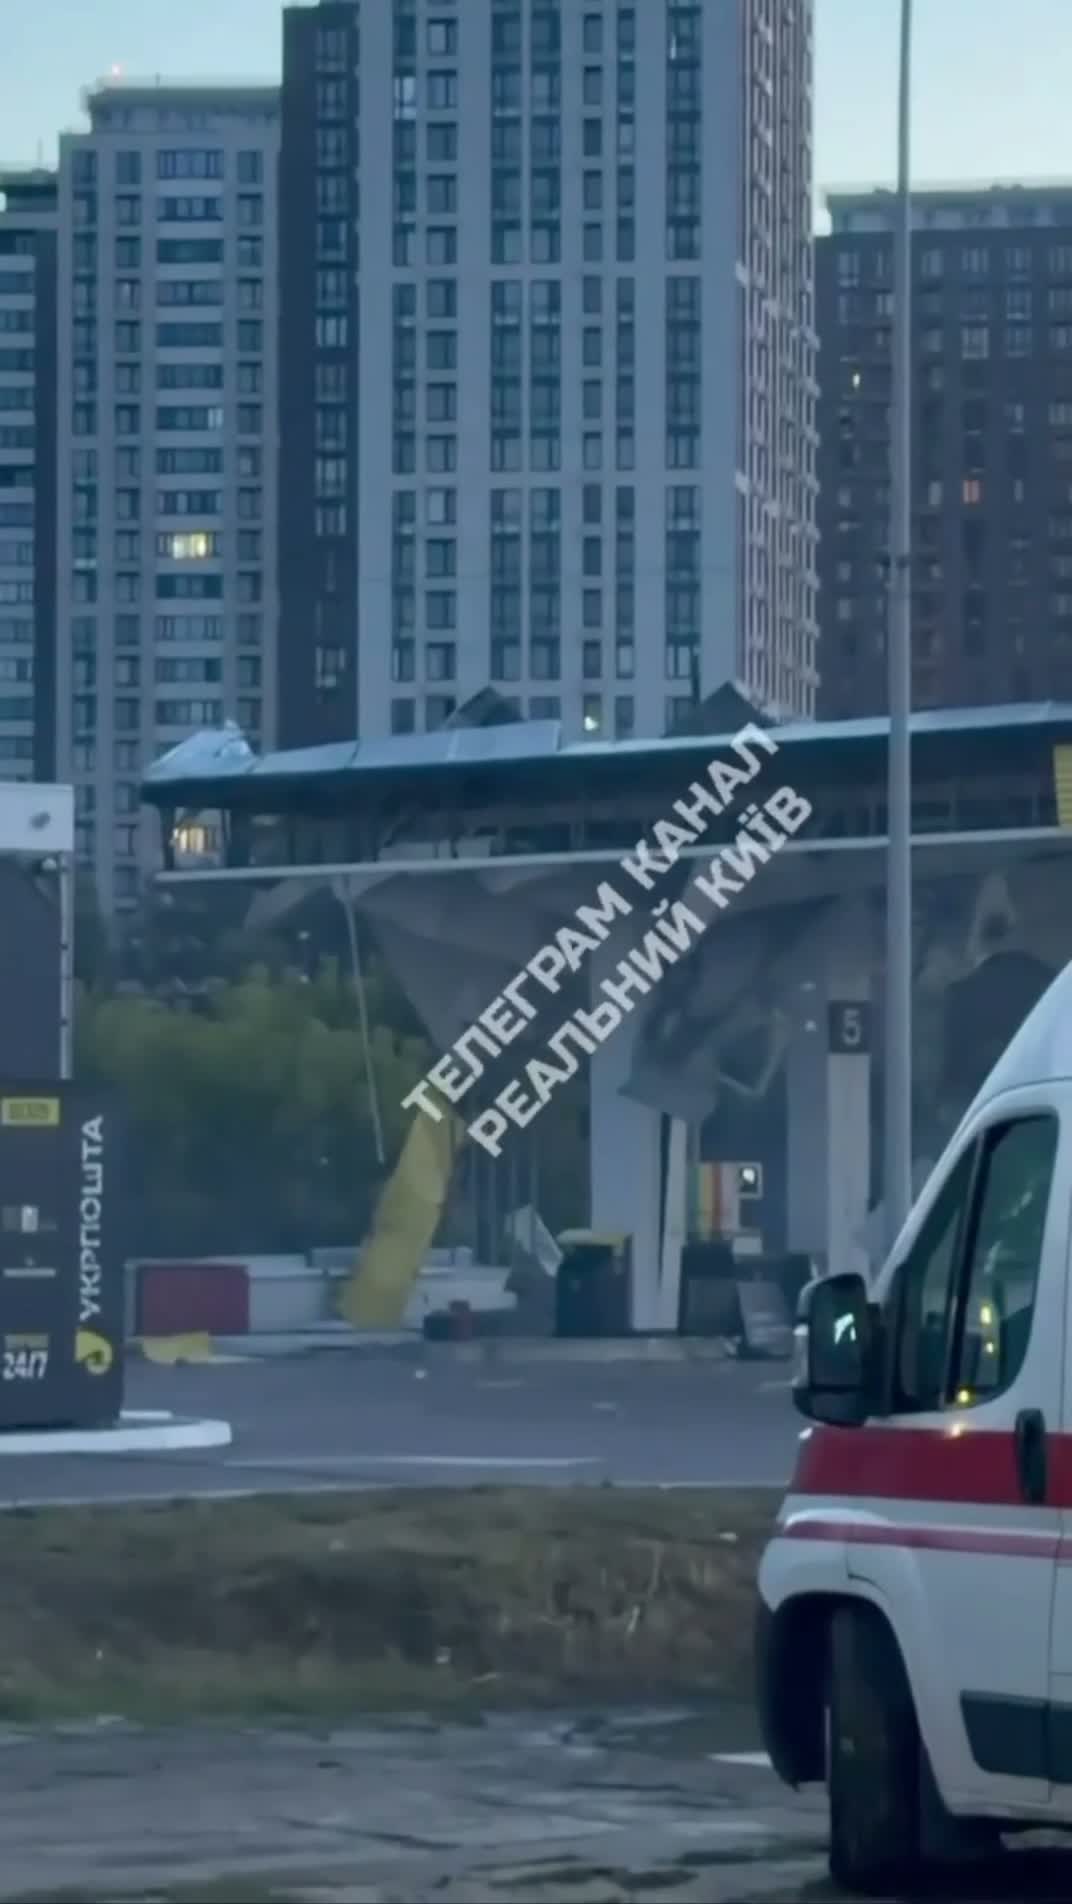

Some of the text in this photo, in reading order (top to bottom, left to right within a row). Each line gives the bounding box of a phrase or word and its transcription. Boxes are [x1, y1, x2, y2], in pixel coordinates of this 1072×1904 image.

[842, 1008, 862, 1046] 5
[79, 1114, 104, 1322] УКРПОШТА
[2, 1351, 49, 1380] 24/7
